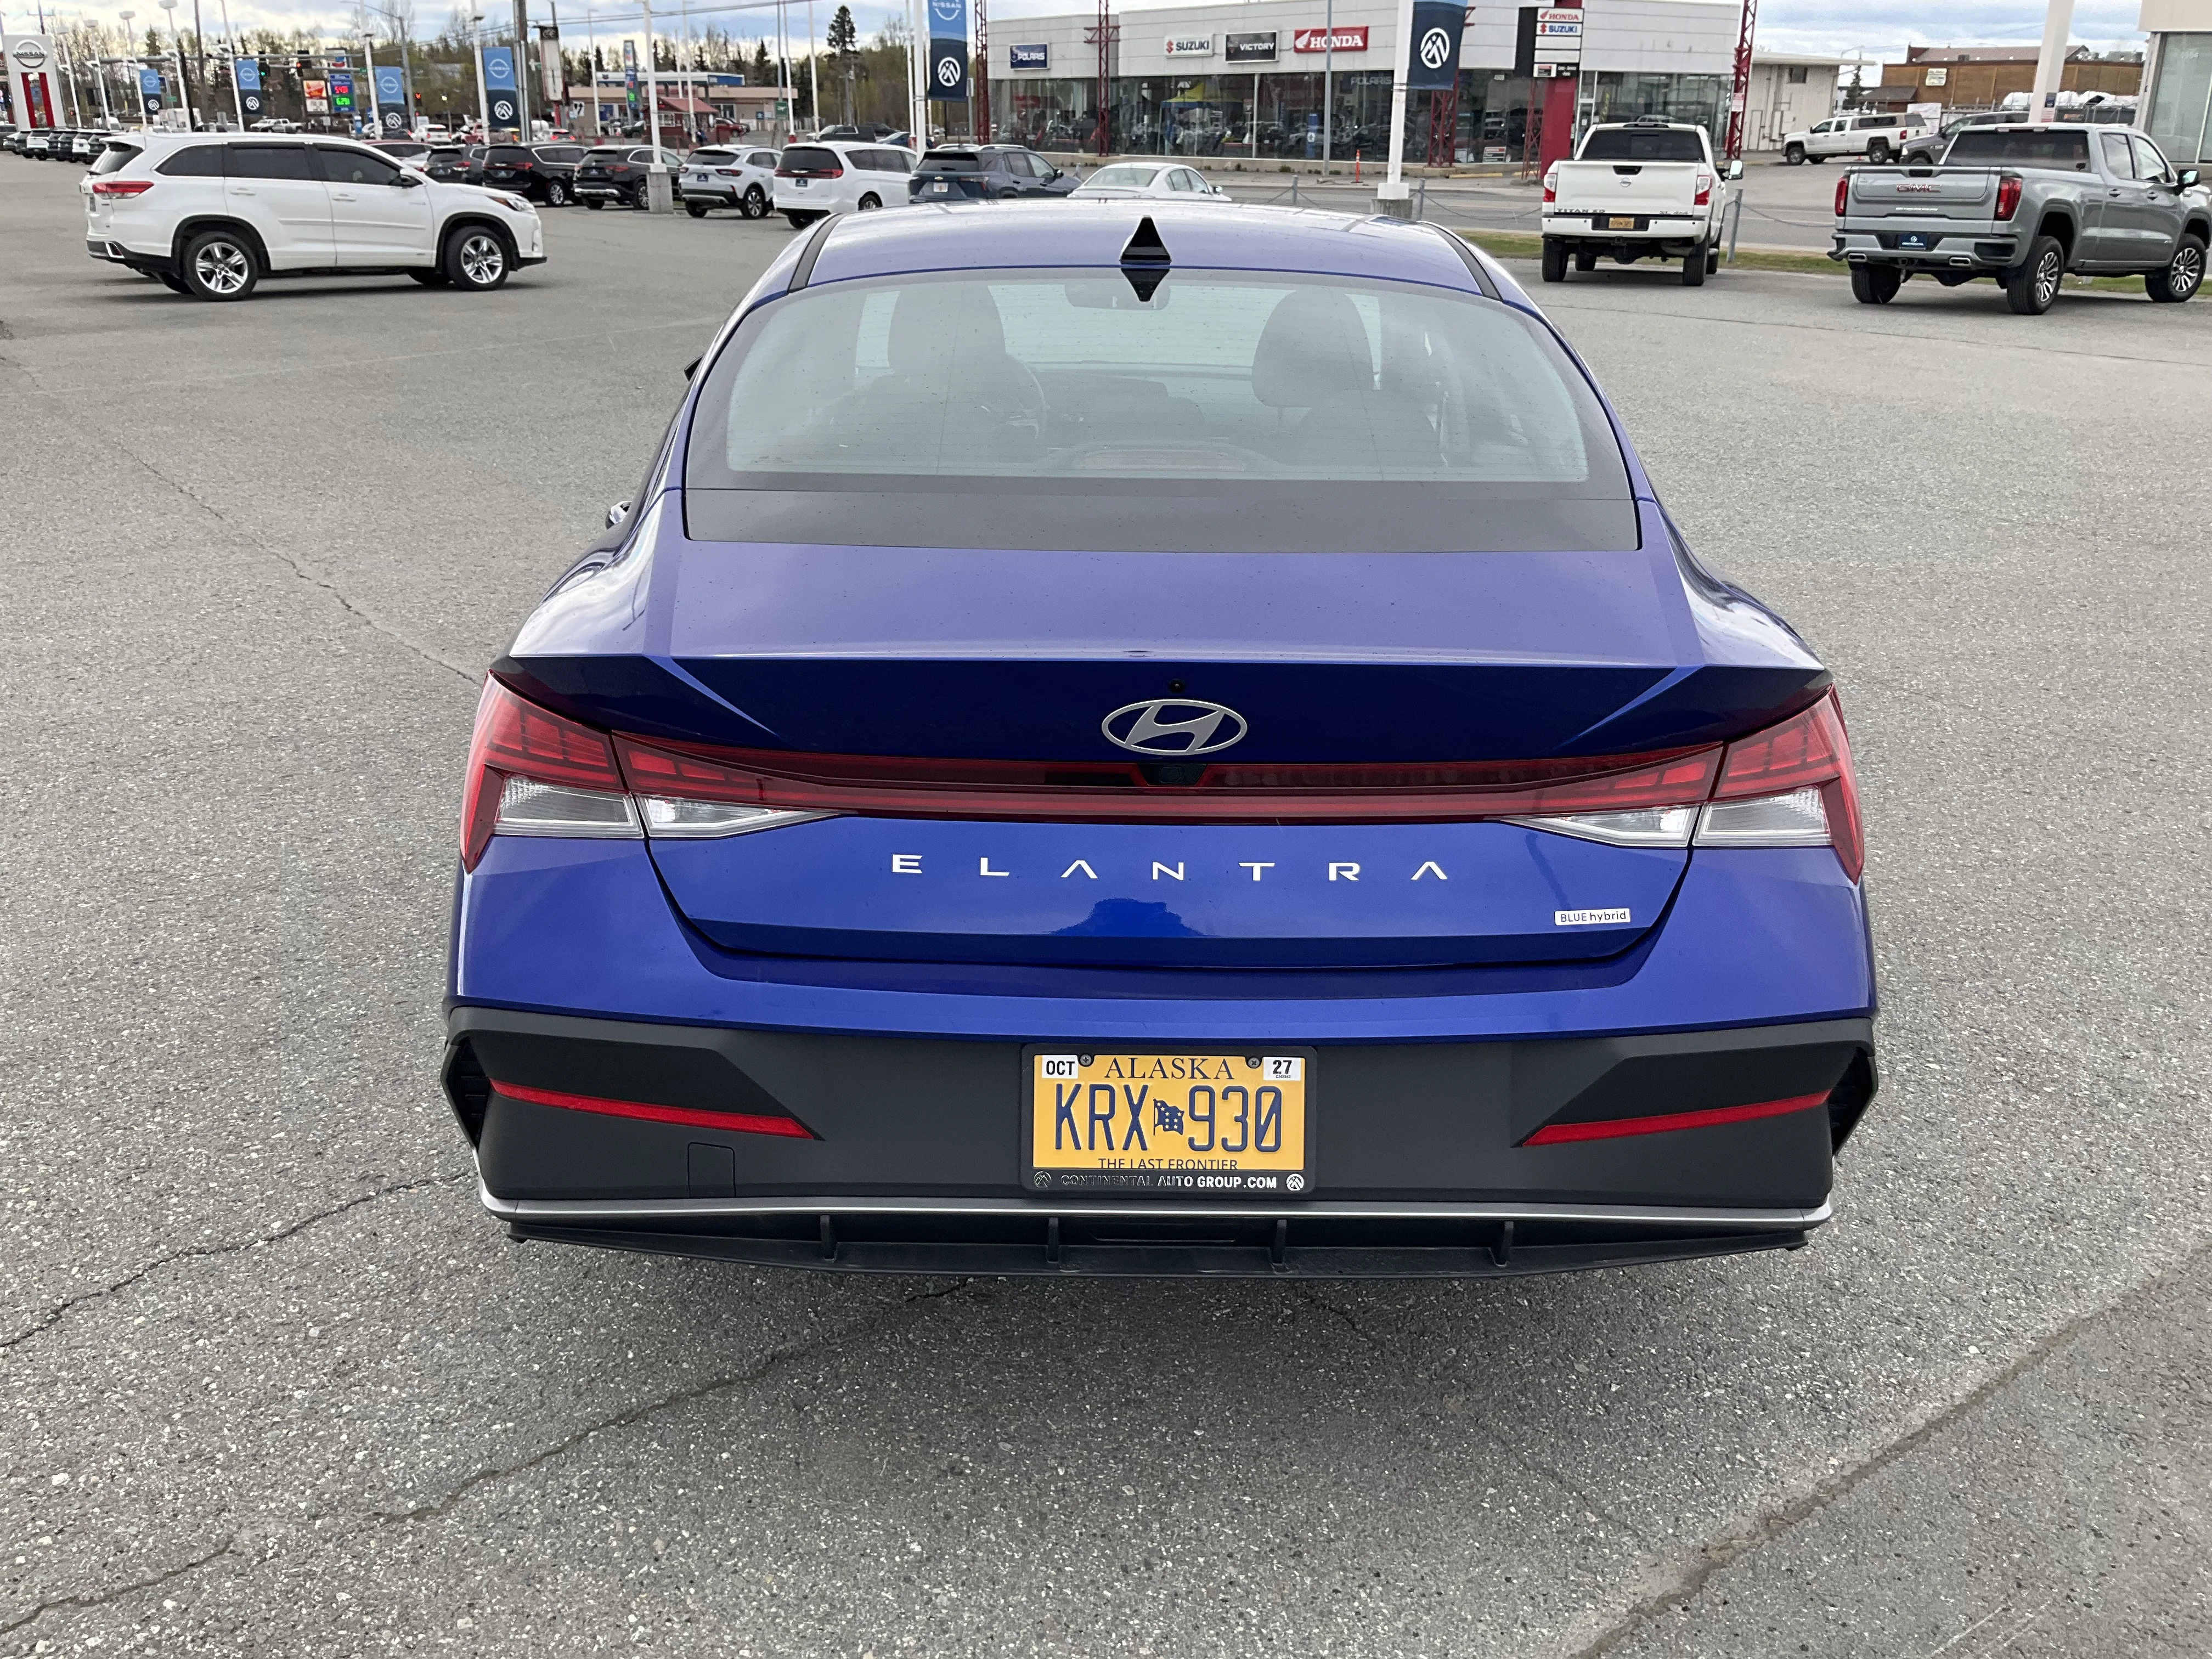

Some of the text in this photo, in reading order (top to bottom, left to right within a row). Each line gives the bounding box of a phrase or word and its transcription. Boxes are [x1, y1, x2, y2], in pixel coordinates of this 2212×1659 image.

[1176, 40, 1209, 51] SUZUKI
[1239, 42, 1274, 50] VICTORY
[1310, 35, 1363, 48] HONDA
[1018, 52, 1045, 60] POLARIS
[1351, 76, 1392, 85] POLARIS
[1897, 184, 1942, 193] GMC
[891, 854, 1448, 881] ELANTRA
[1560, 911, 1626, 922] BLUE hybrid
[1046, 1060, 1075, 1075] OCT
[1104, 1057, 1234, 1080] ALASKA
[1273, 1059, 1292, 1074] 27
[1055, 1084, 1282, 1153] KRX 930
[1098, 1158, 1238, 1170] THE LAST FRONTIER
[1061, 1175, 1151, 1186] CONTINENTAL
[1158, 1176, 1193, 1187] AUTO
